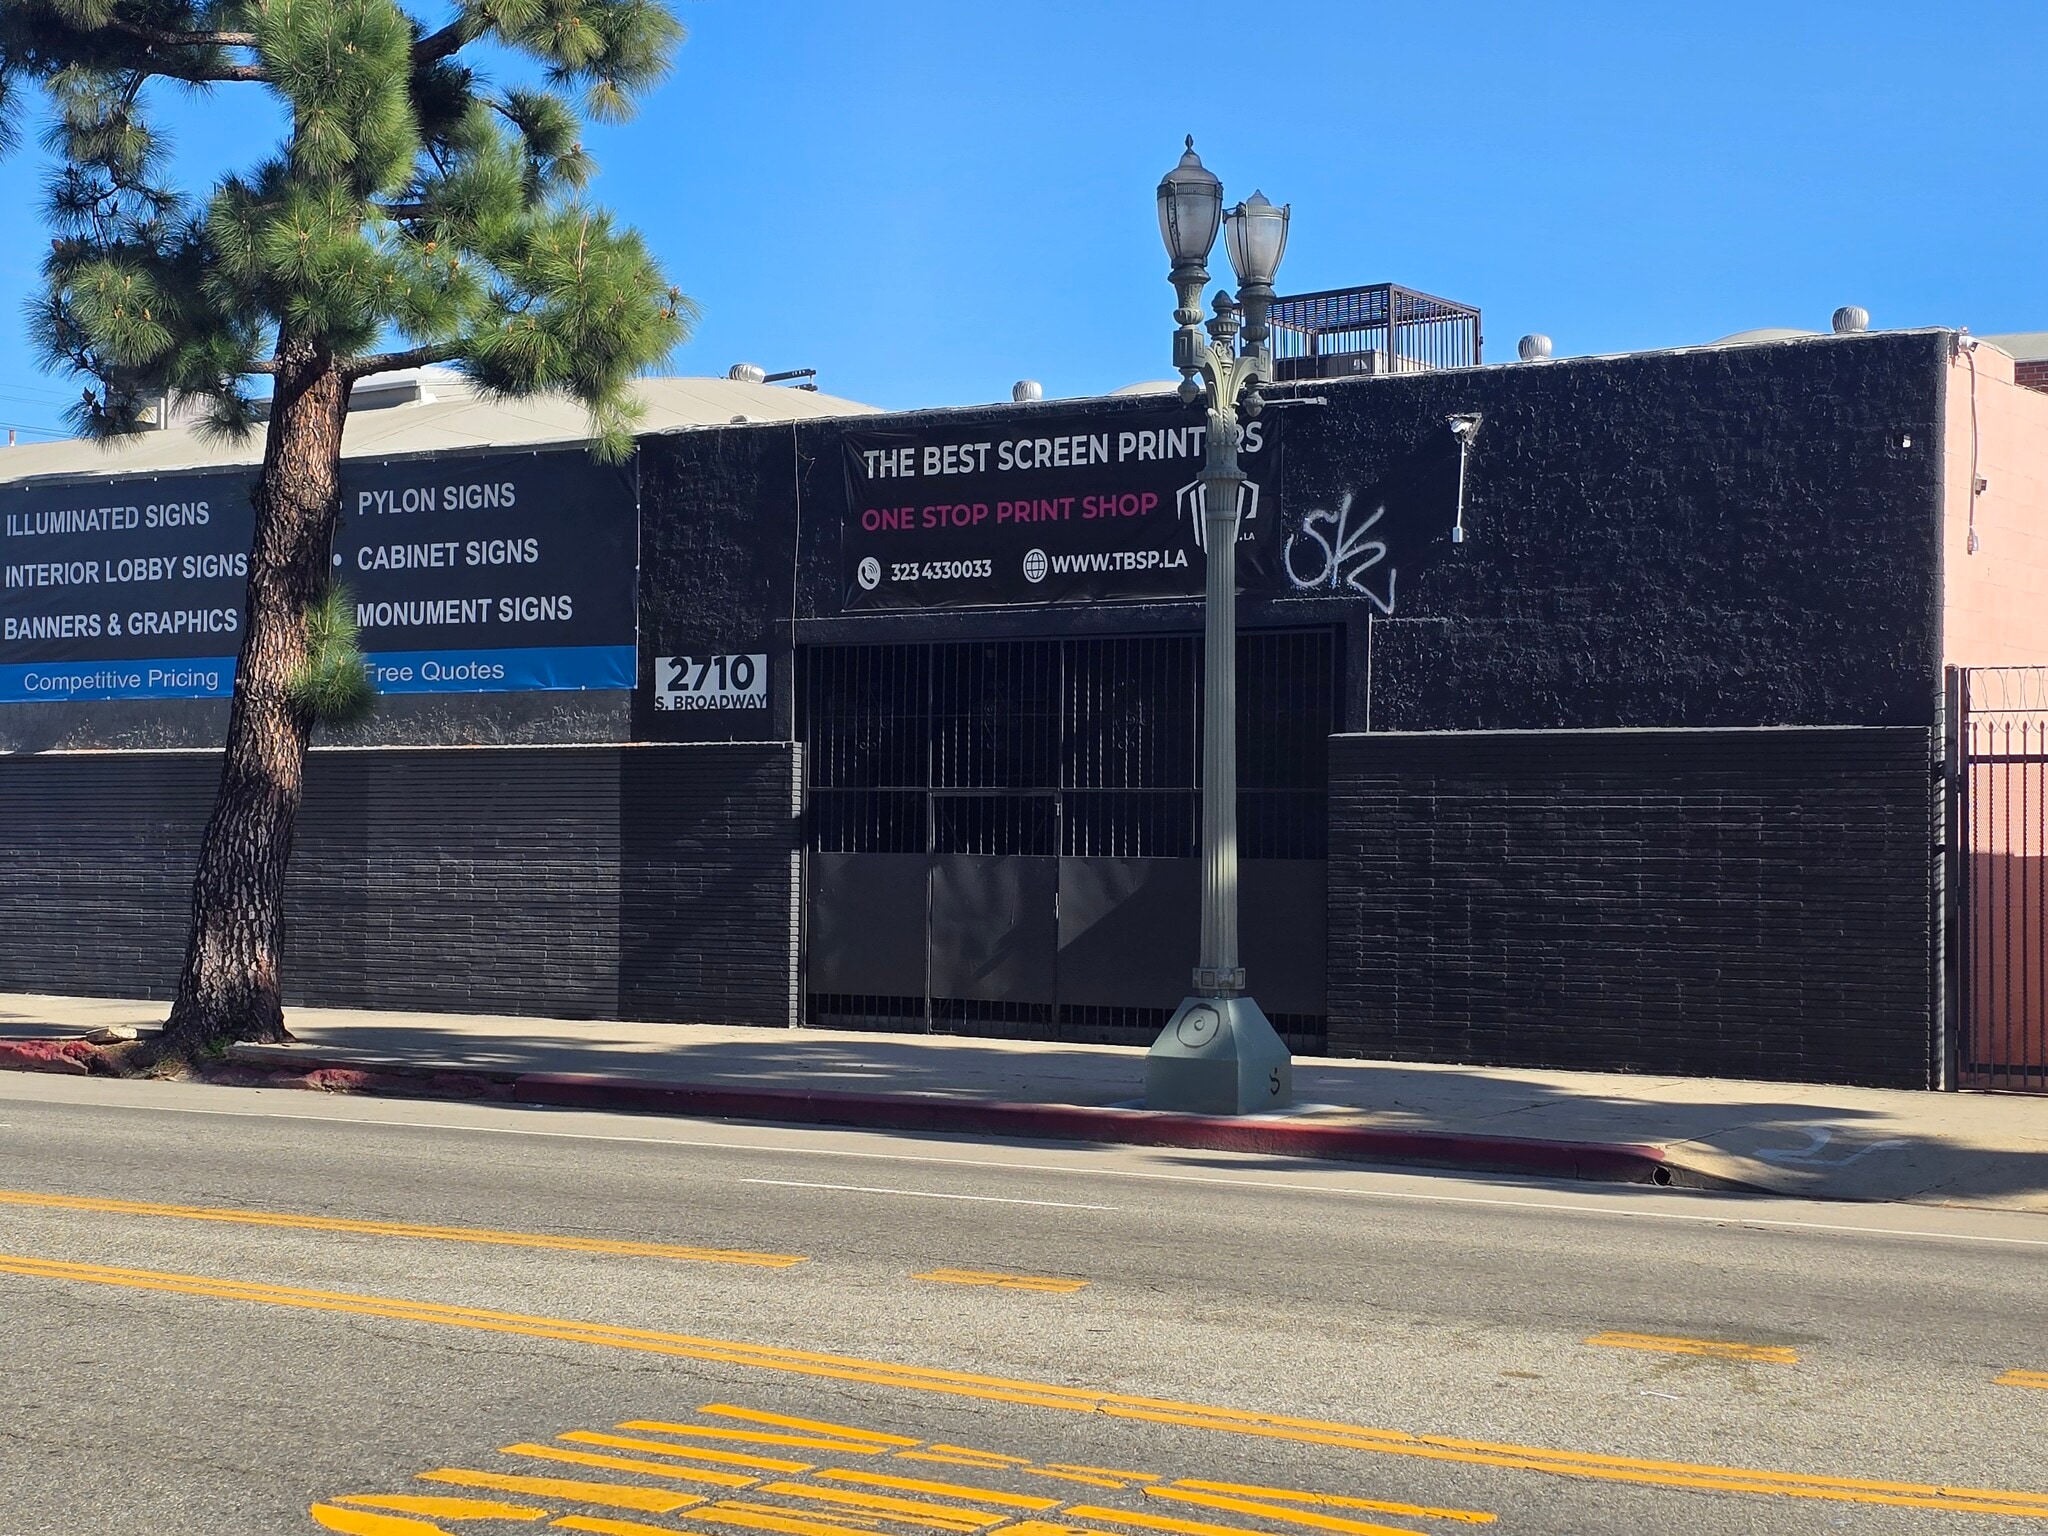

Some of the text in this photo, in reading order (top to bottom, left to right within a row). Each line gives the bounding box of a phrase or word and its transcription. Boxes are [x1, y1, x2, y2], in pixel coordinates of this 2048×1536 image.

[863, 421, 1264, 479] THE BEST SCREEN PRINTRS
[358, 482, 517, 515] PYLON SIGNS
[861, 492, 1159, 531] ONE STOP PRINT SHOP
[6, 501, 210, 537] ILLUMINATED SIGNS
[5, 552, 248, 588] INTERIOR LOBBY SIGNS
[357, 538, 540, 571] CABINET SIGNS
[1051, 549, 1189, 574] WWW.TBSP.LA
[4, 608, 239, 640] BANNERS & GRAPHICS
[356, 595, 573, 627] MONUMENT SIGNS
[24, 668, 219, 694] Competitive Pricing
[362, 660, 505, 683] Free Quotes
[667, 655, 755, 692] 2710
[673, 693, 767, 710] BROADWAY
